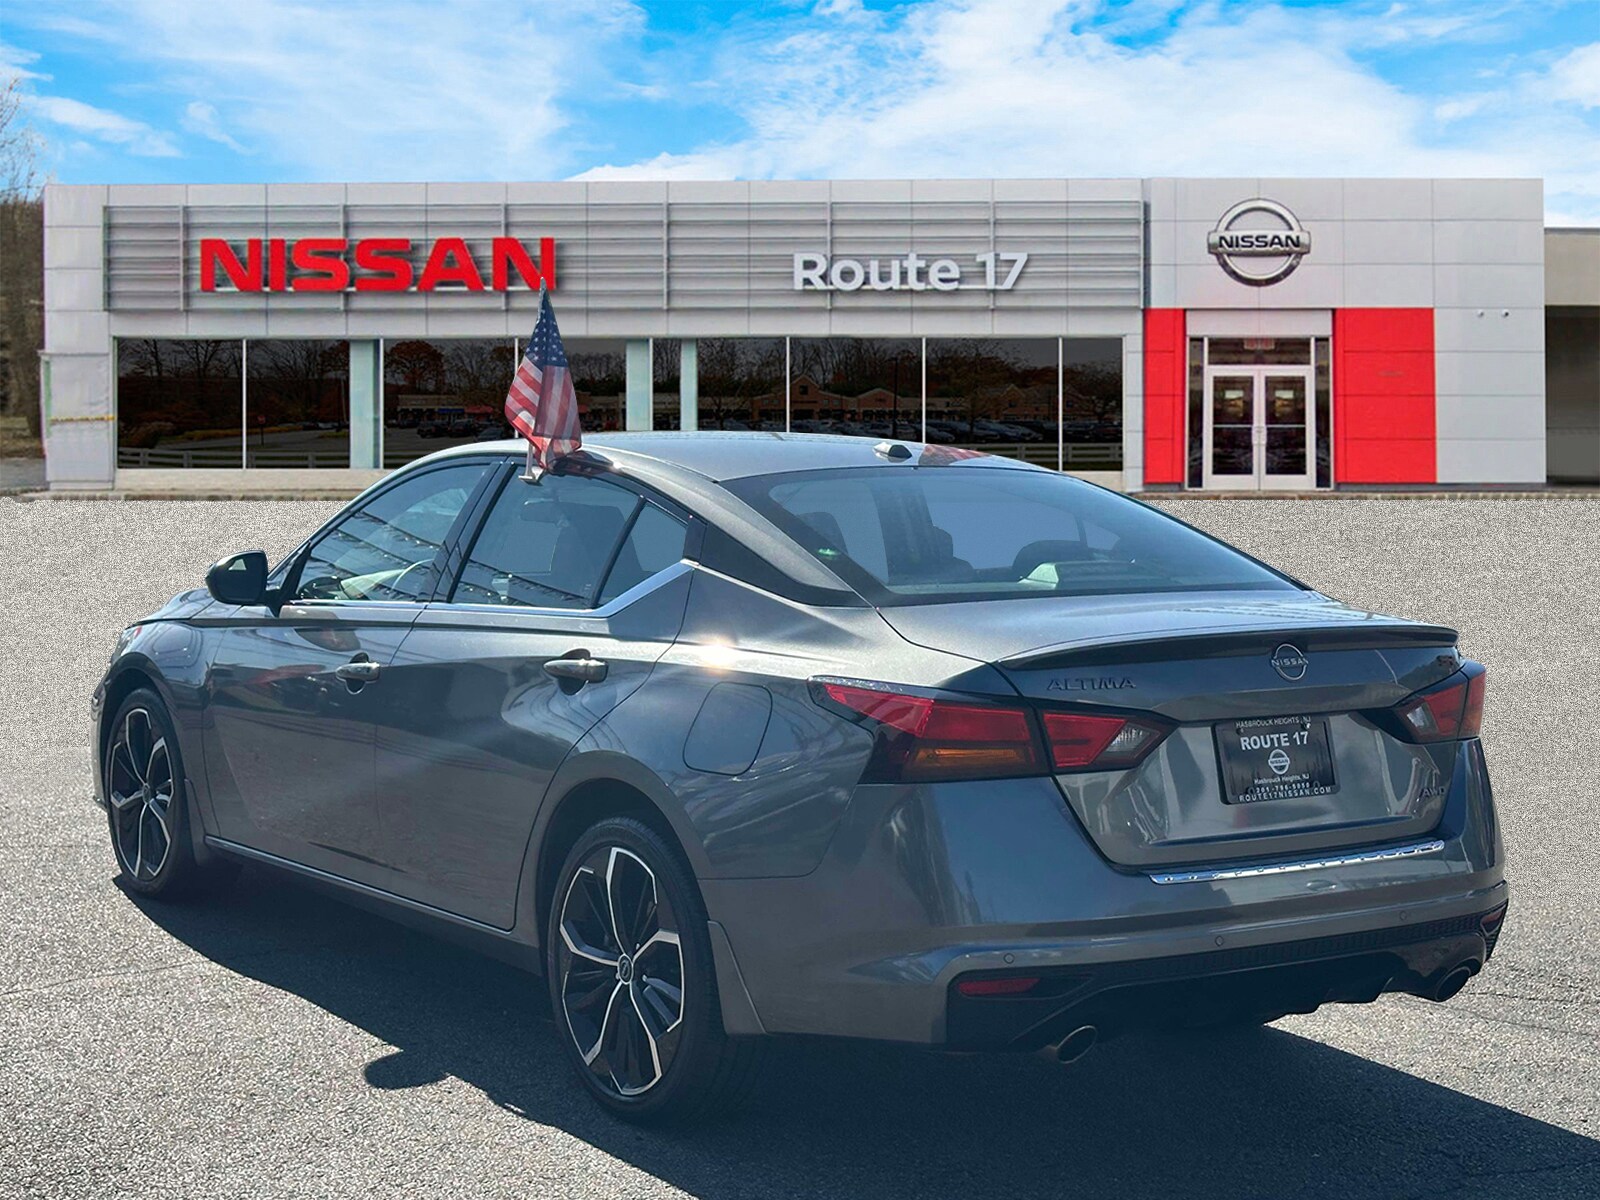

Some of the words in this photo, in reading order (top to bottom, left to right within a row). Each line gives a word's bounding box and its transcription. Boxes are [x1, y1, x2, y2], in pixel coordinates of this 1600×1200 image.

[1219, 234, 1300, 249] NISSAN
[200, 237, 556, 292] NISSAN
[793, 252, 960, 291] Route
[976, 252, 1028, 290] 17
[1271, 657, 1309, 667] NISSAN
[1046, 677, 1137, 691] ALTIMA
[1240, 733, 1290, 751] ROUTE
[1293, 731, 1309, 745] 17
